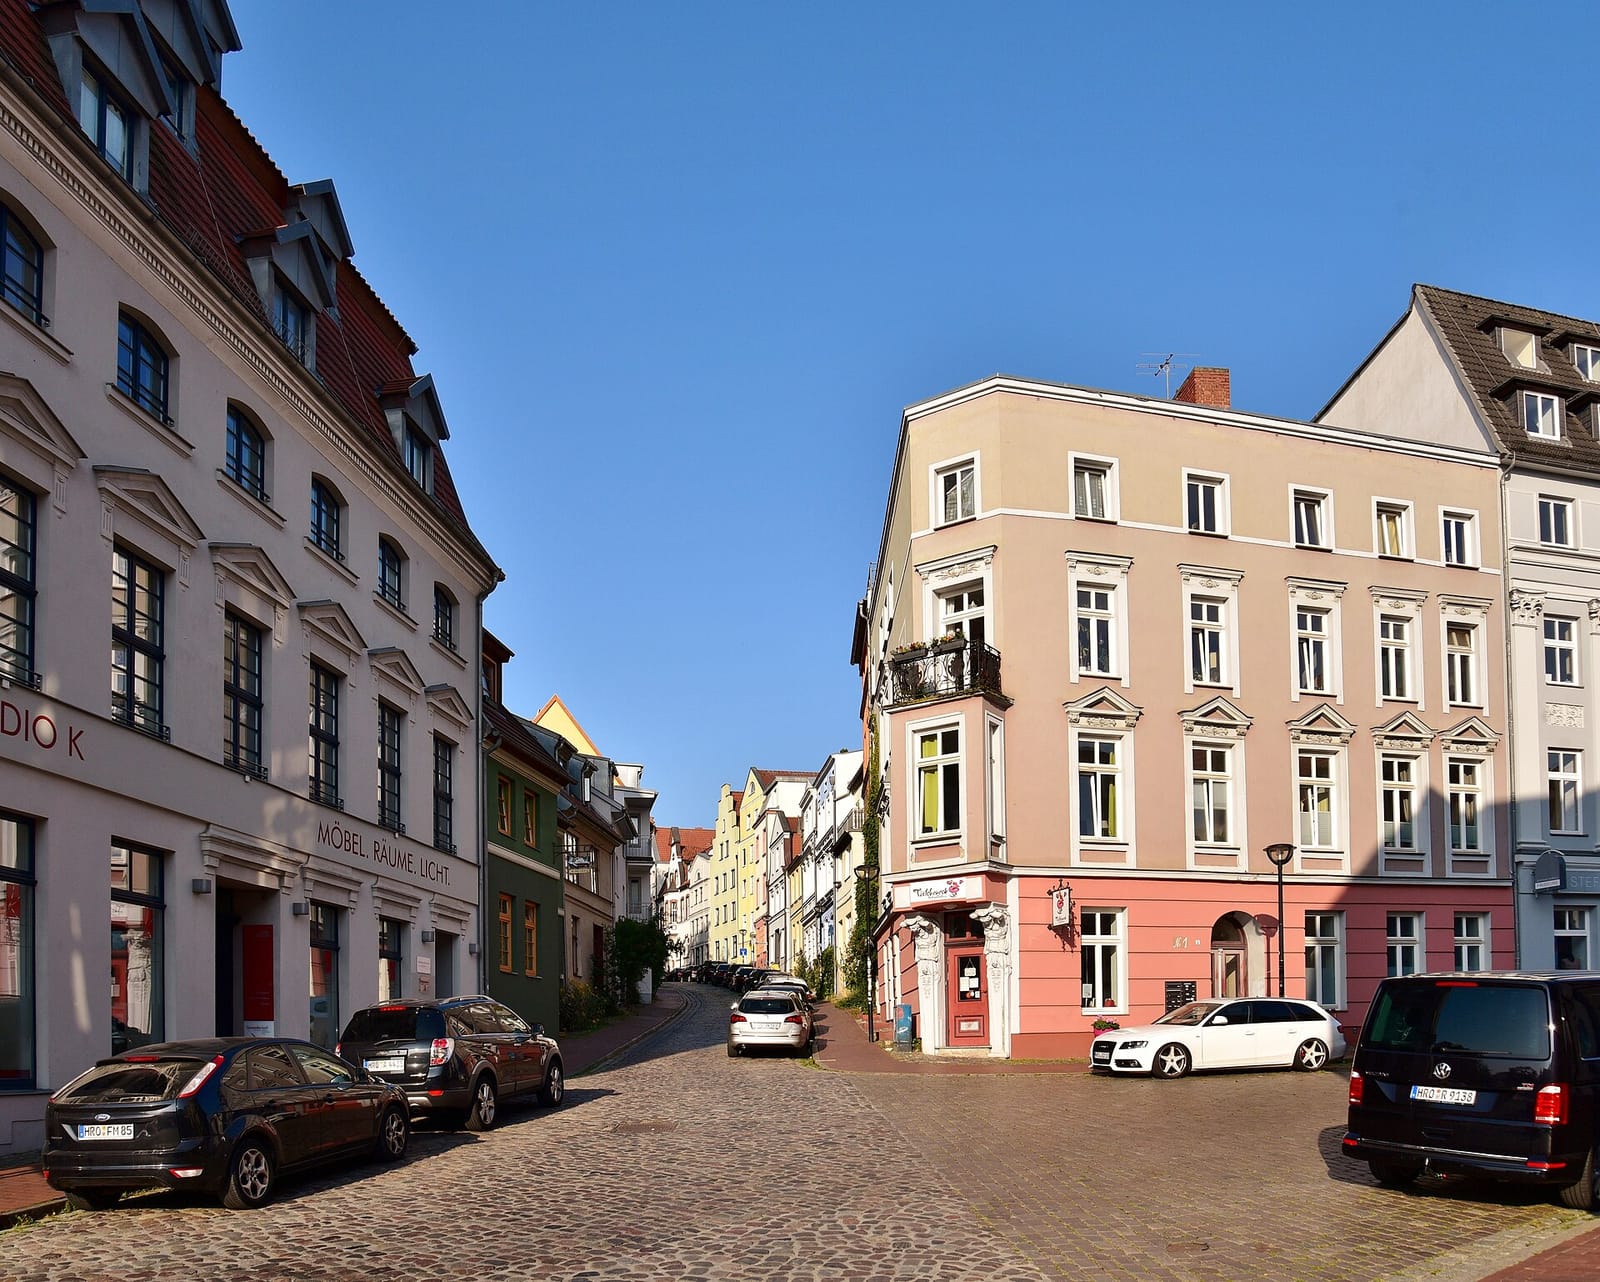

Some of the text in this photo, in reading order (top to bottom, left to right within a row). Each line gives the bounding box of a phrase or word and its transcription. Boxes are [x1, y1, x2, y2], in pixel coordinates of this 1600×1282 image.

[0, 700, 84, 761] DIO K
[317, 820, 451, 886] MÖBEL. RÄUME. LICHT.
[1416, 1088, 1473, 1103] HRO R 9138
[84, 1124, 132, 1137] HRO FM 85
